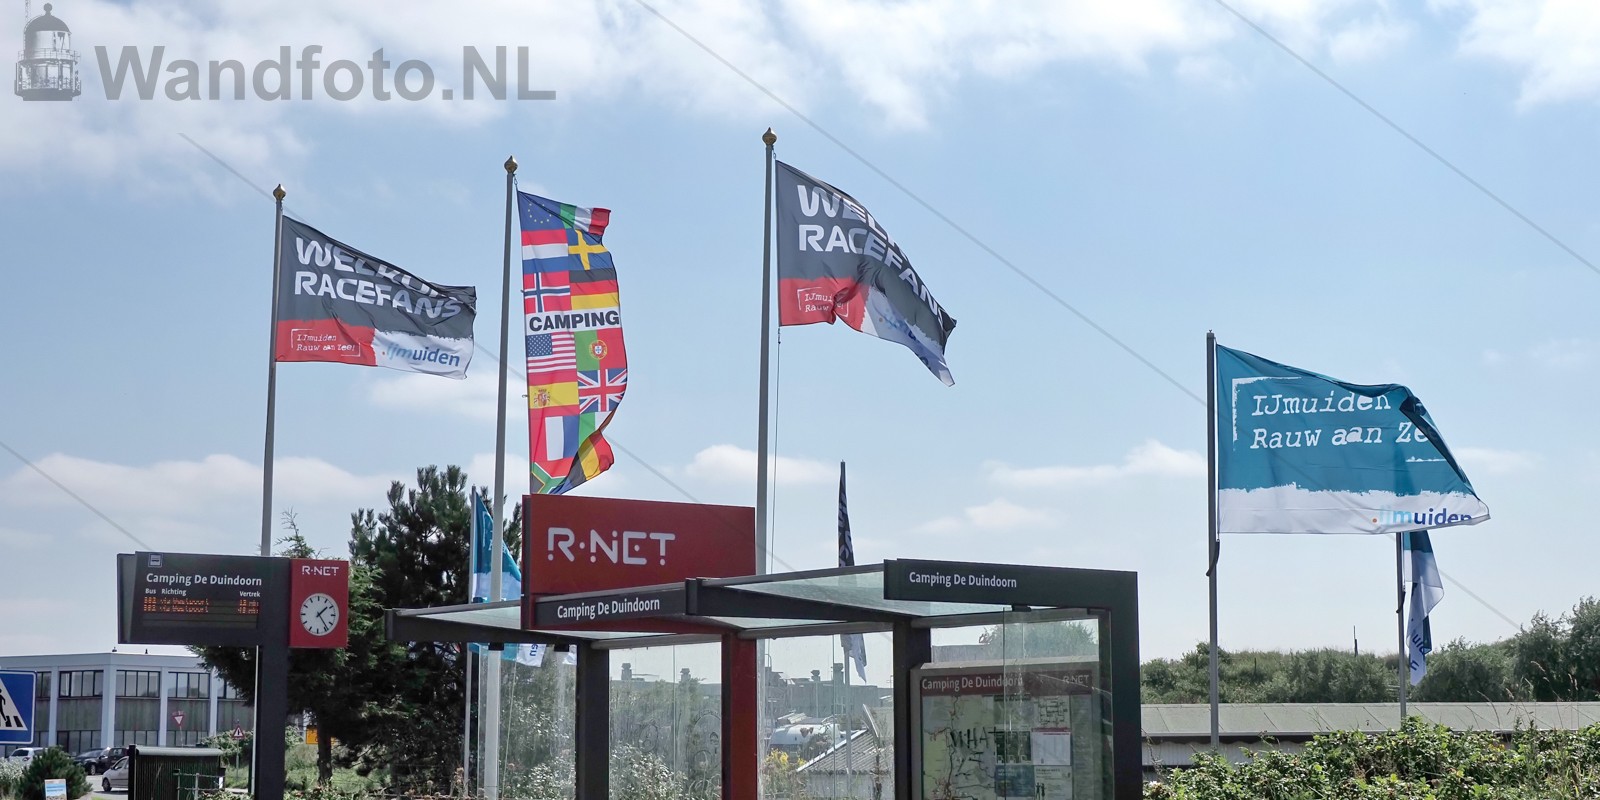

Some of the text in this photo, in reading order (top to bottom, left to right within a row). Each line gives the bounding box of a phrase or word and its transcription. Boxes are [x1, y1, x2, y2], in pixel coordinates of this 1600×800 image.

[797, 185, 908, 262] WEL
[294, 271, 462, 319] RACEFANS
[804, 292, 832, 302] IJmui
[529, 310, 620, 332] CAMPING
[296, 333, 337, 342] IJmuiden
[296, 343, 320, 351] Rauw
[1251, 391, 1391, 416] IJmuiden
[1250, 421, 1429, 450] Rauw aan Ze
[146, 573, 262, 587] Camping De Duindoorn
[909, 571, 1017, 588] Camping De Duindoorn
[161, 588, 187, 597] Richting
[239, 590, 261, 598] Vertrek
[557, 597, 660, 620] Camping De Duindoorn
[922, 677, 960, 692] Camping
[961, 677, 974, 689] De
[976, 675, 1024, 688] Duindoorn
